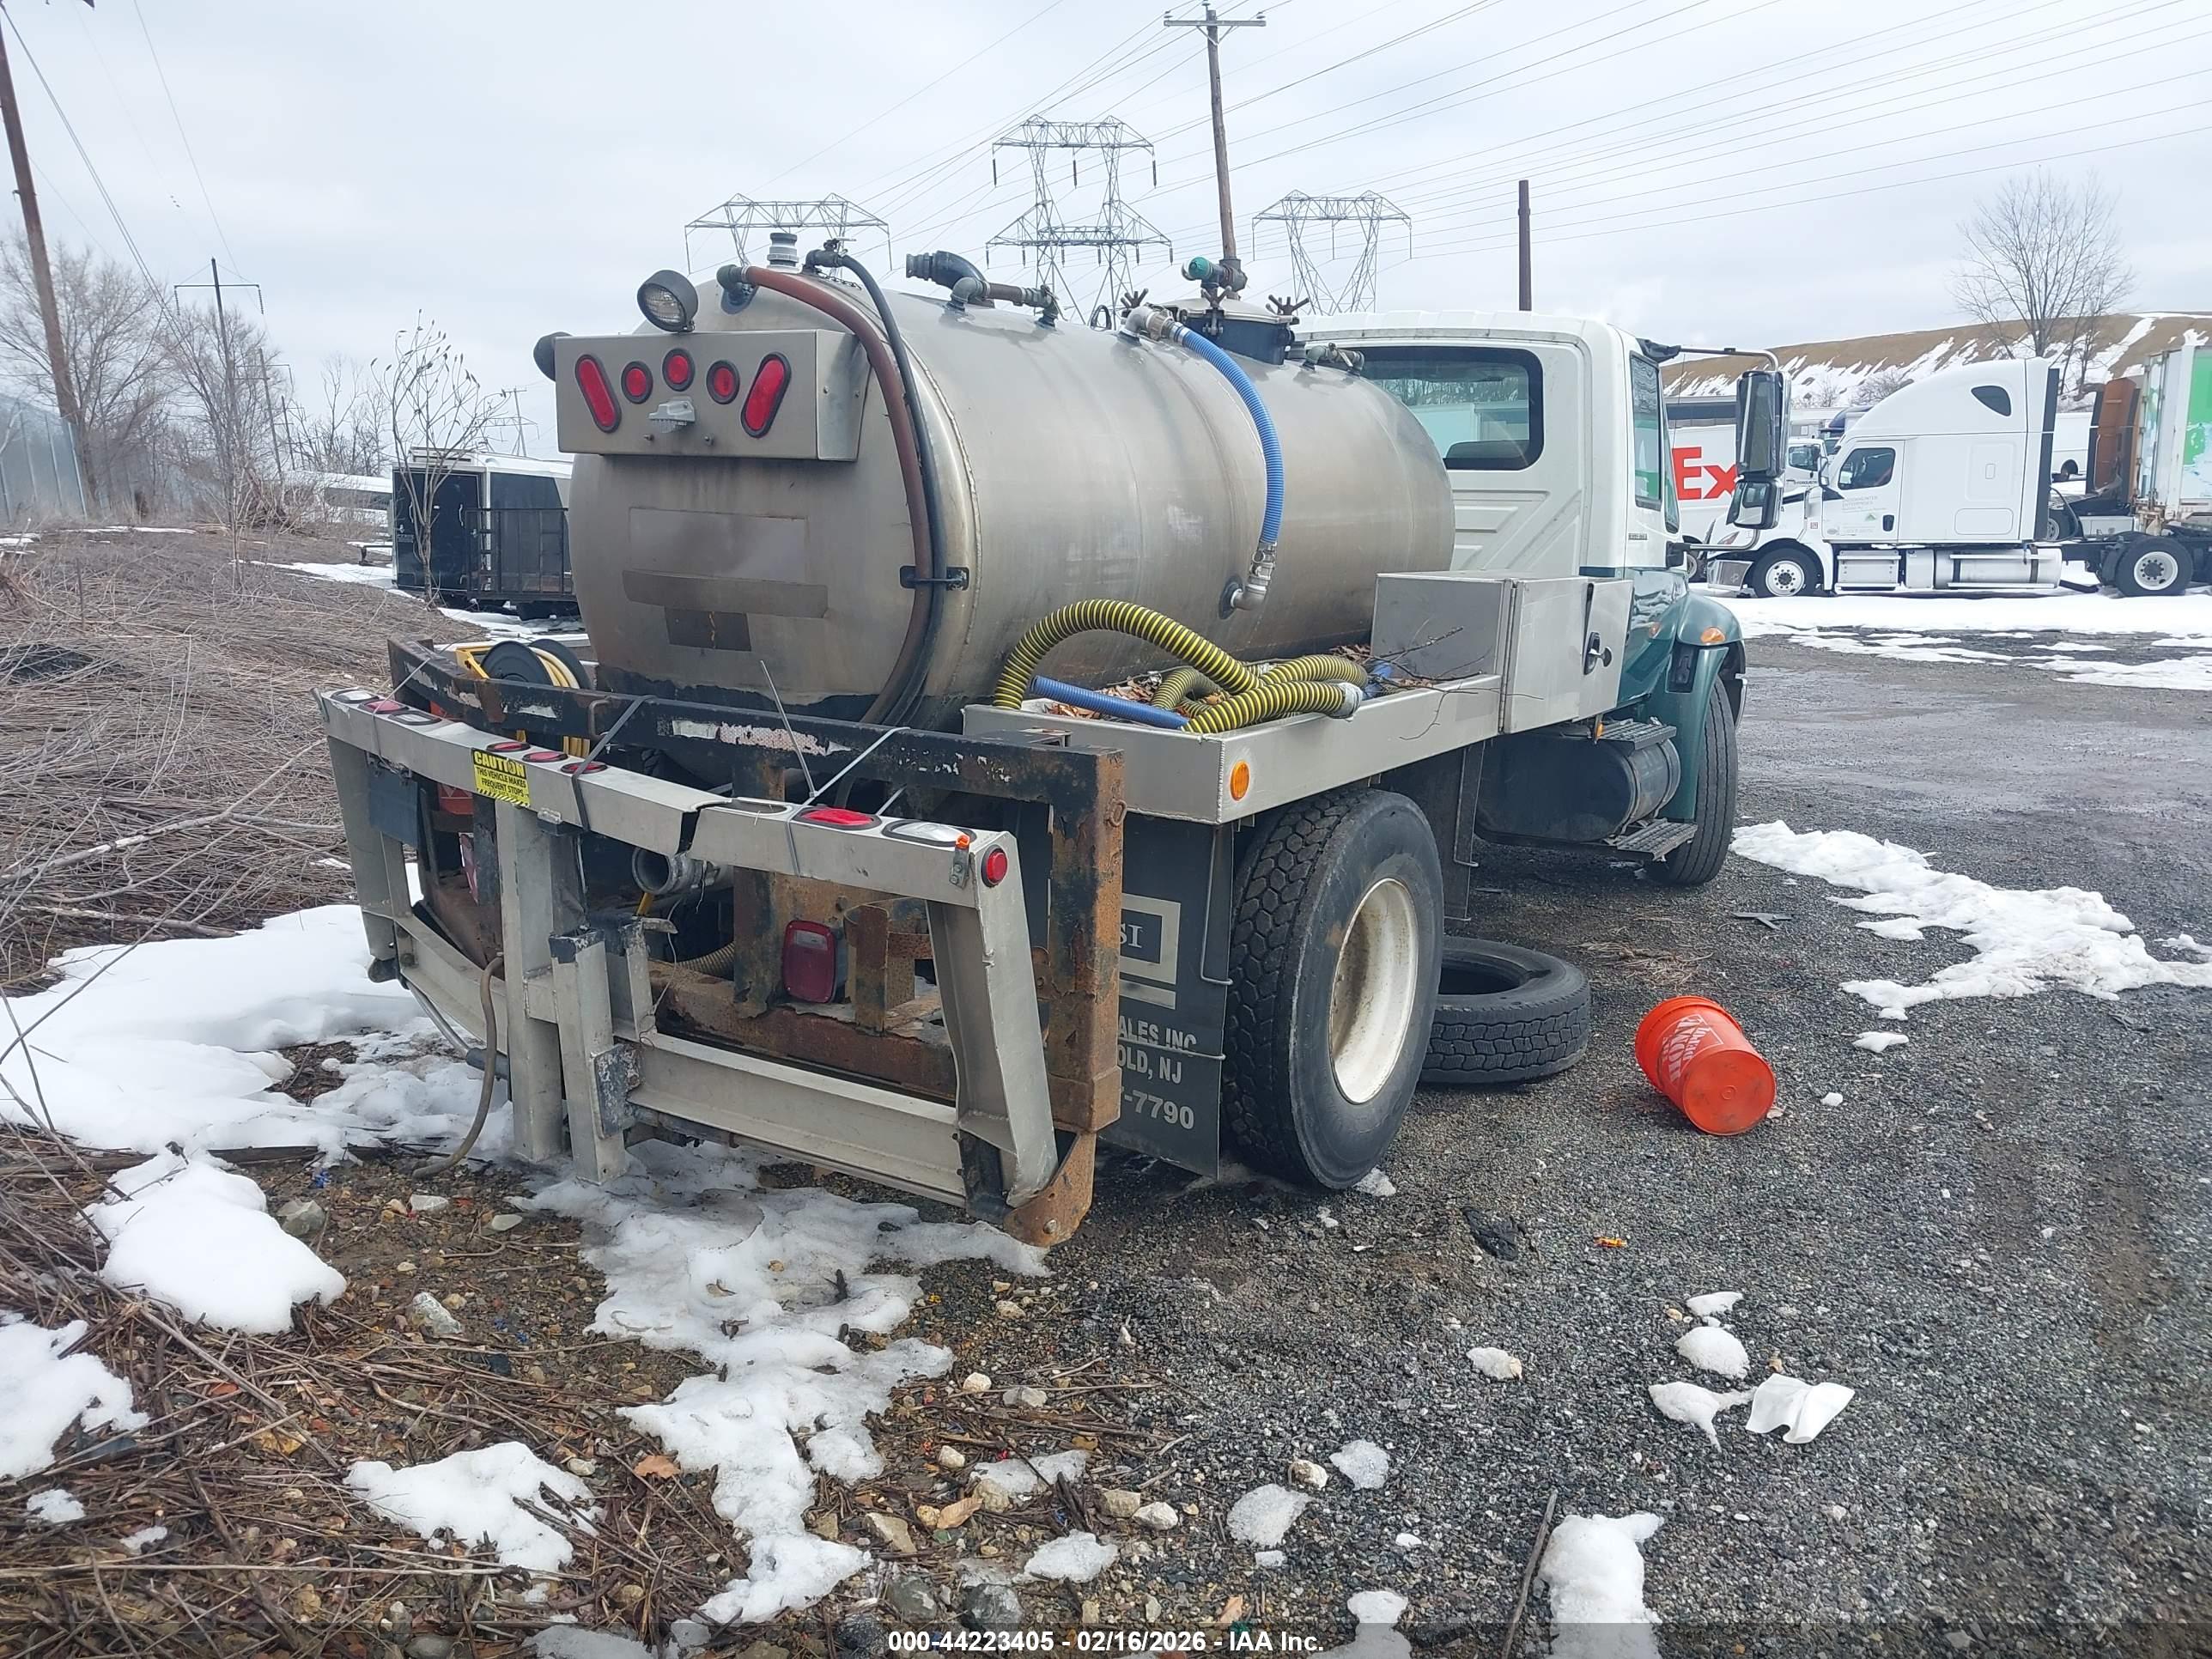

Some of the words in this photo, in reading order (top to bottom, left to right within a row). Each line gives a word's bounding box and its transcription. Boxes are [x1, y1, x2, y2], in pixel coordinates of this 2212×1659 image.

[1671, 447, 1736, 500] Ex
[474, 750, 525, 778] CAUTION
[477, 767, 488, 777] THIS
[487, 769, 508, 783] VEHICLE
[507, 776, 526, 788] MAKES
[481, 778, 507, 792] FREQUENT
[507, 785, 525, 797] STOPS
[1118, 1015, 1159, 1045] ALES
[1165, 1027, 1197, 1057] INC
[1117, 1044, 1153, 1079] OLD,
[1159, 1055, 1182, 1084] NJ
[1121, 1086, 1194, 1129] -7790
